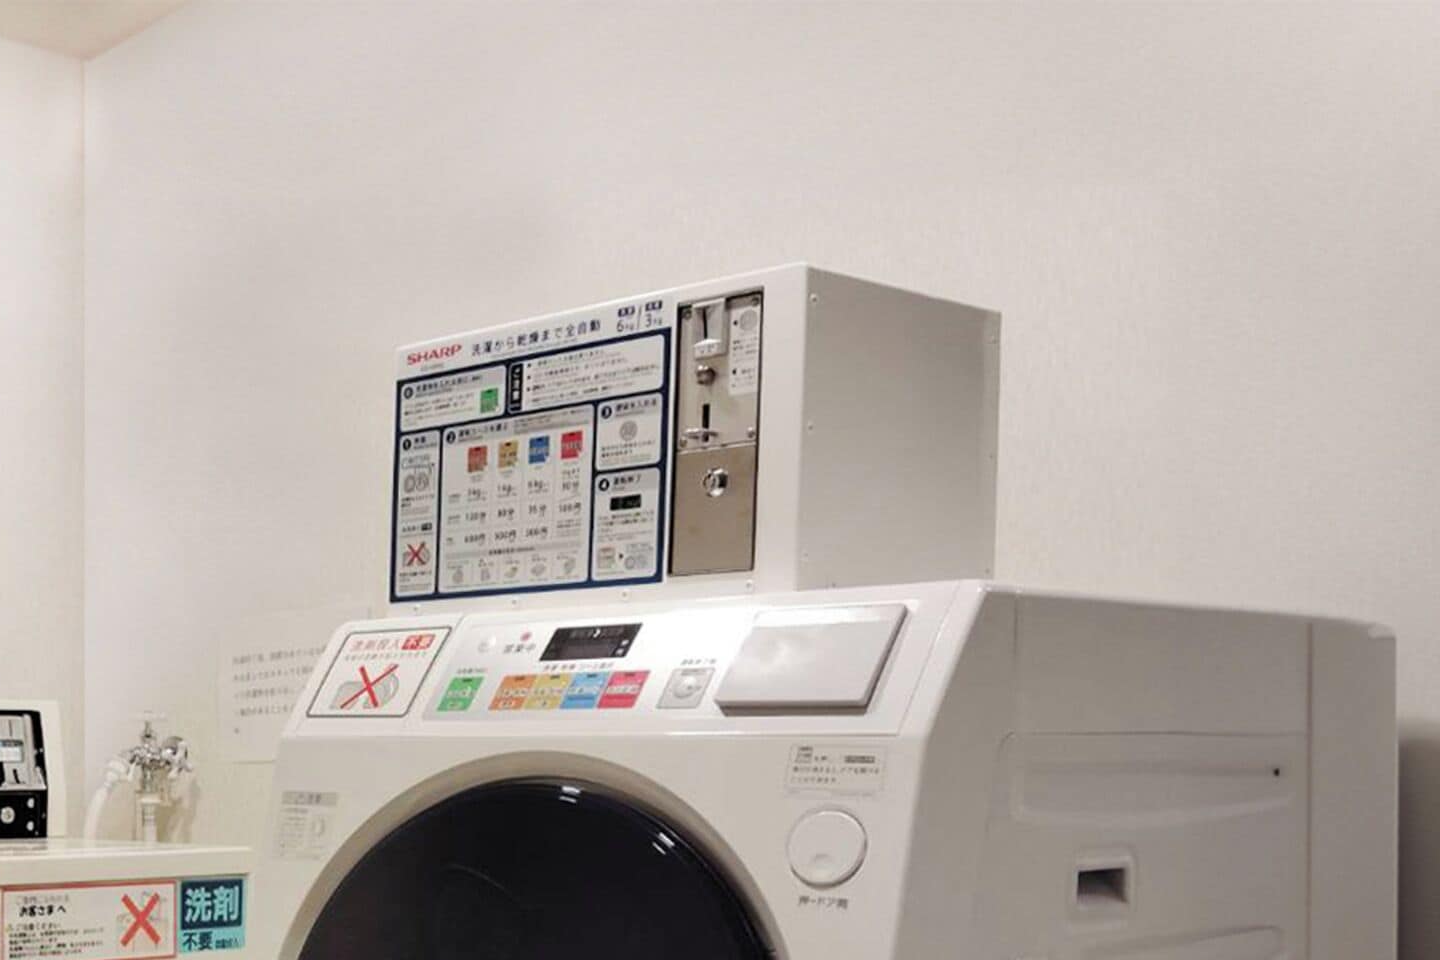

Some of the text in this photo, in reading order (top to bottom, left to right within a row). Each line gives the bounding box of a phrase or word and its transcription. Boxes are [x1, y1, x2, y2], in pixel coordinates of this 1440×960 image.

[471, 319, 601, 358] 洗濯から乾燥まで全自動
[407, 343, 462, 366] SHARP
[185, 885, 240, 923] 洗剤
[182, 930, 213, 952] 不要
